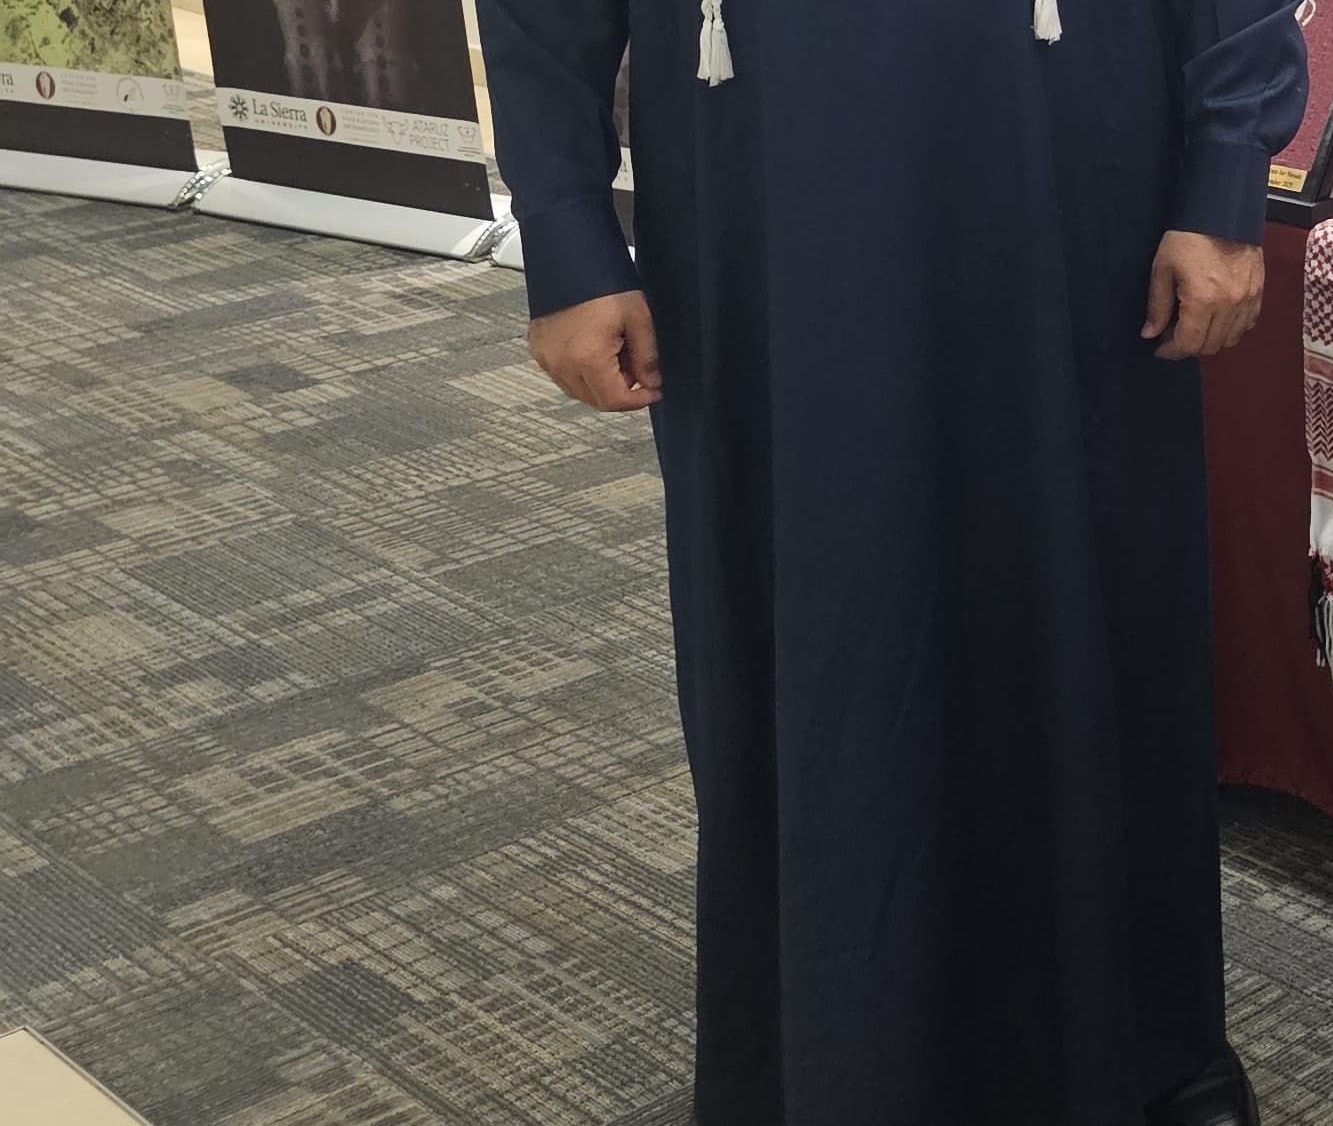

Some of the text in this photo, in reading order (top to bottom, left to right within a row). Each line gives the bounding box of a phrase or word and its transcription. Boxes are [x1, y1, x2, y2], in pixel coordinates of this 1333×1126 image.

[250, 97, 308, 122] La Sierra
[408, 133, 449, 152] PROJECT
